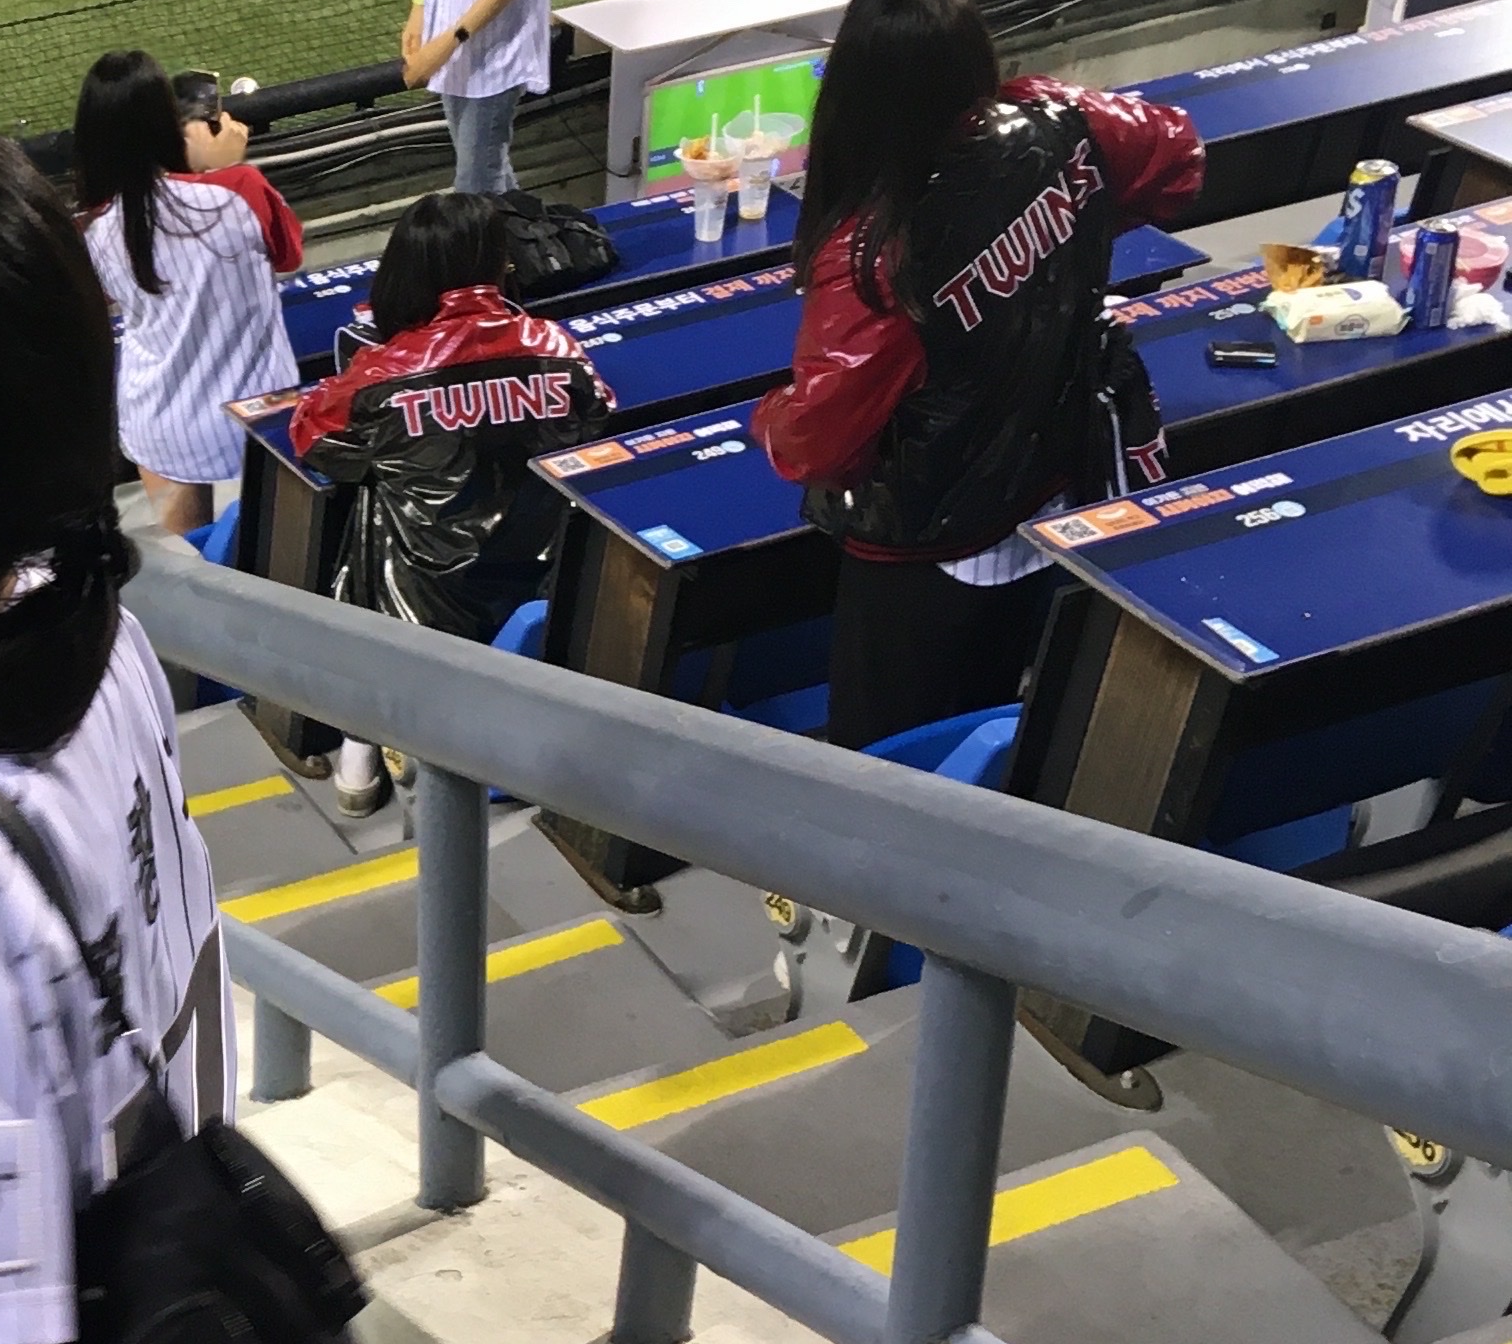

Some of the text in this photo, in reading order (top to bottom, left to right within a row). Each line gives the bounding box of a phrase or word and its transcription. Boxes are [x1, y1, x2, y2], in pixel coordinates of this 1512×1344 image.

[933, 137, 1104, 332] TWINS
[568, 291, 706, 333] 음식주문부터
[1155, 287, 1219, 308] 까지
[390, 372, 572, 437] TWINS
[1235, 507, 1282, 528] 256
